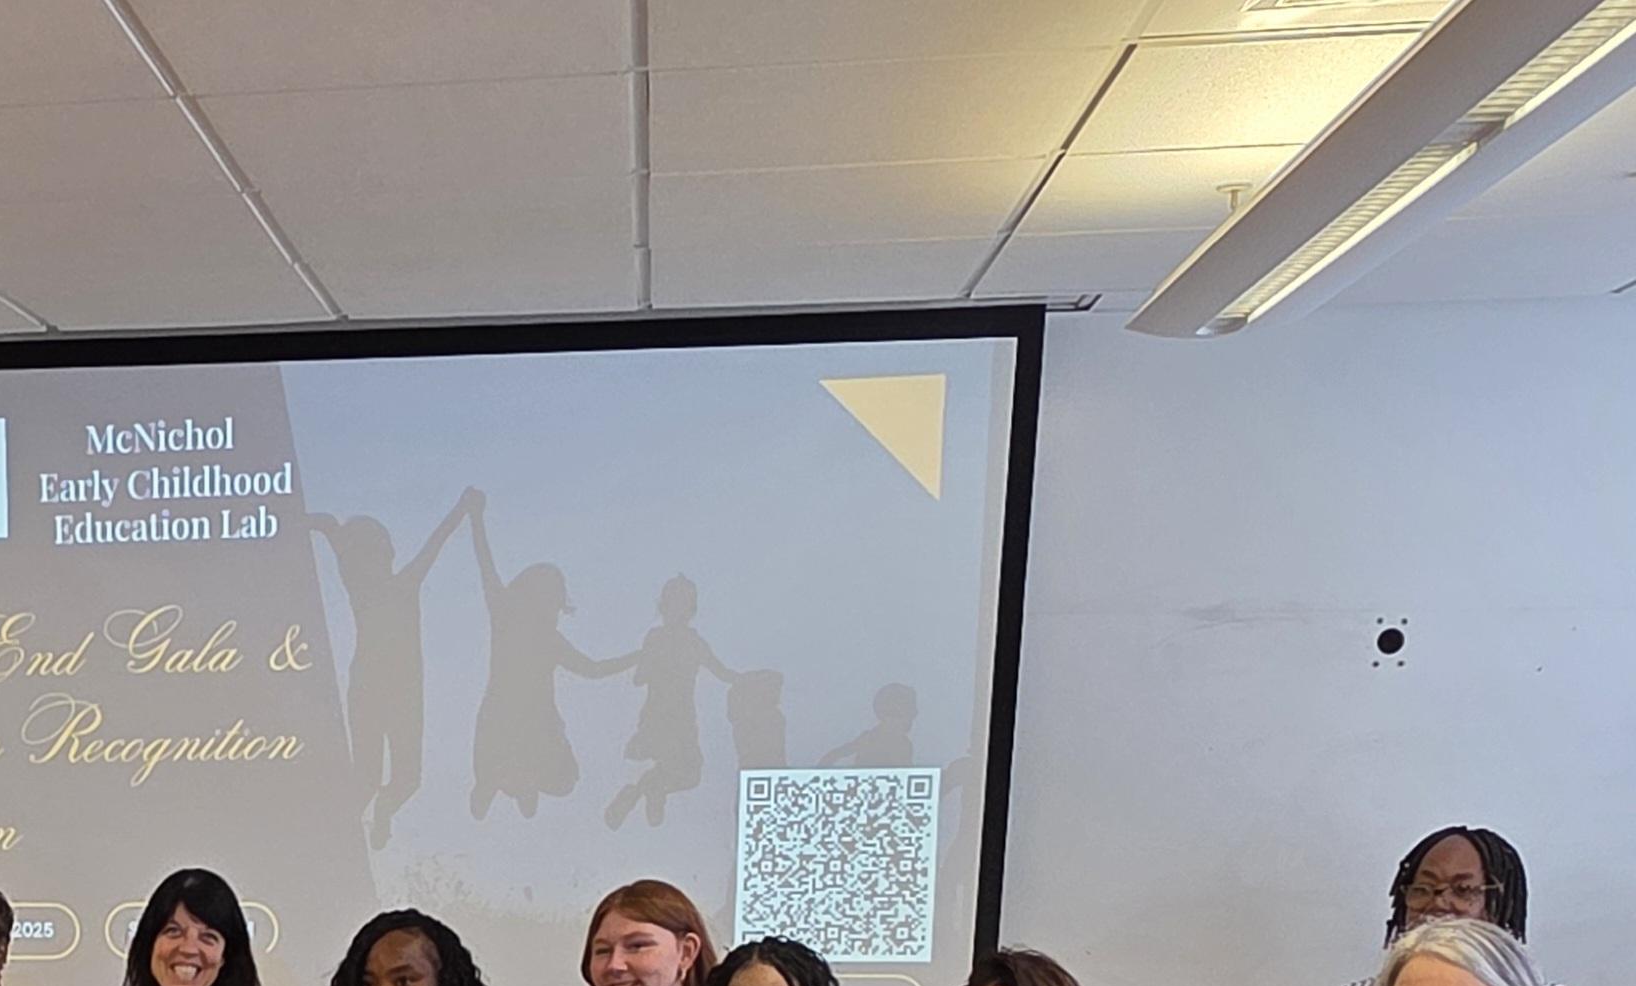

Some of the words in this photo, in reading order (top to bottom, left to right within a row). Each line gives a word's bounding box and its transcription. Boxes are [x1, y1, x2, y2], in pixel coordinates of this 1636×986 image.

[86, 417, 233, 455] McNichol
[39, 469, 119, 508] Early
[127, 462, 292, 500] Childhood
[54, 509, 211, 545] Education
[220, 506, 278, 539] Lab
[103, 604, 243, 675] Gala
[268, 623, 313, 672] &
[20, 692, 303, 788] Recognition
[12, 921, 54, 938] 2025
